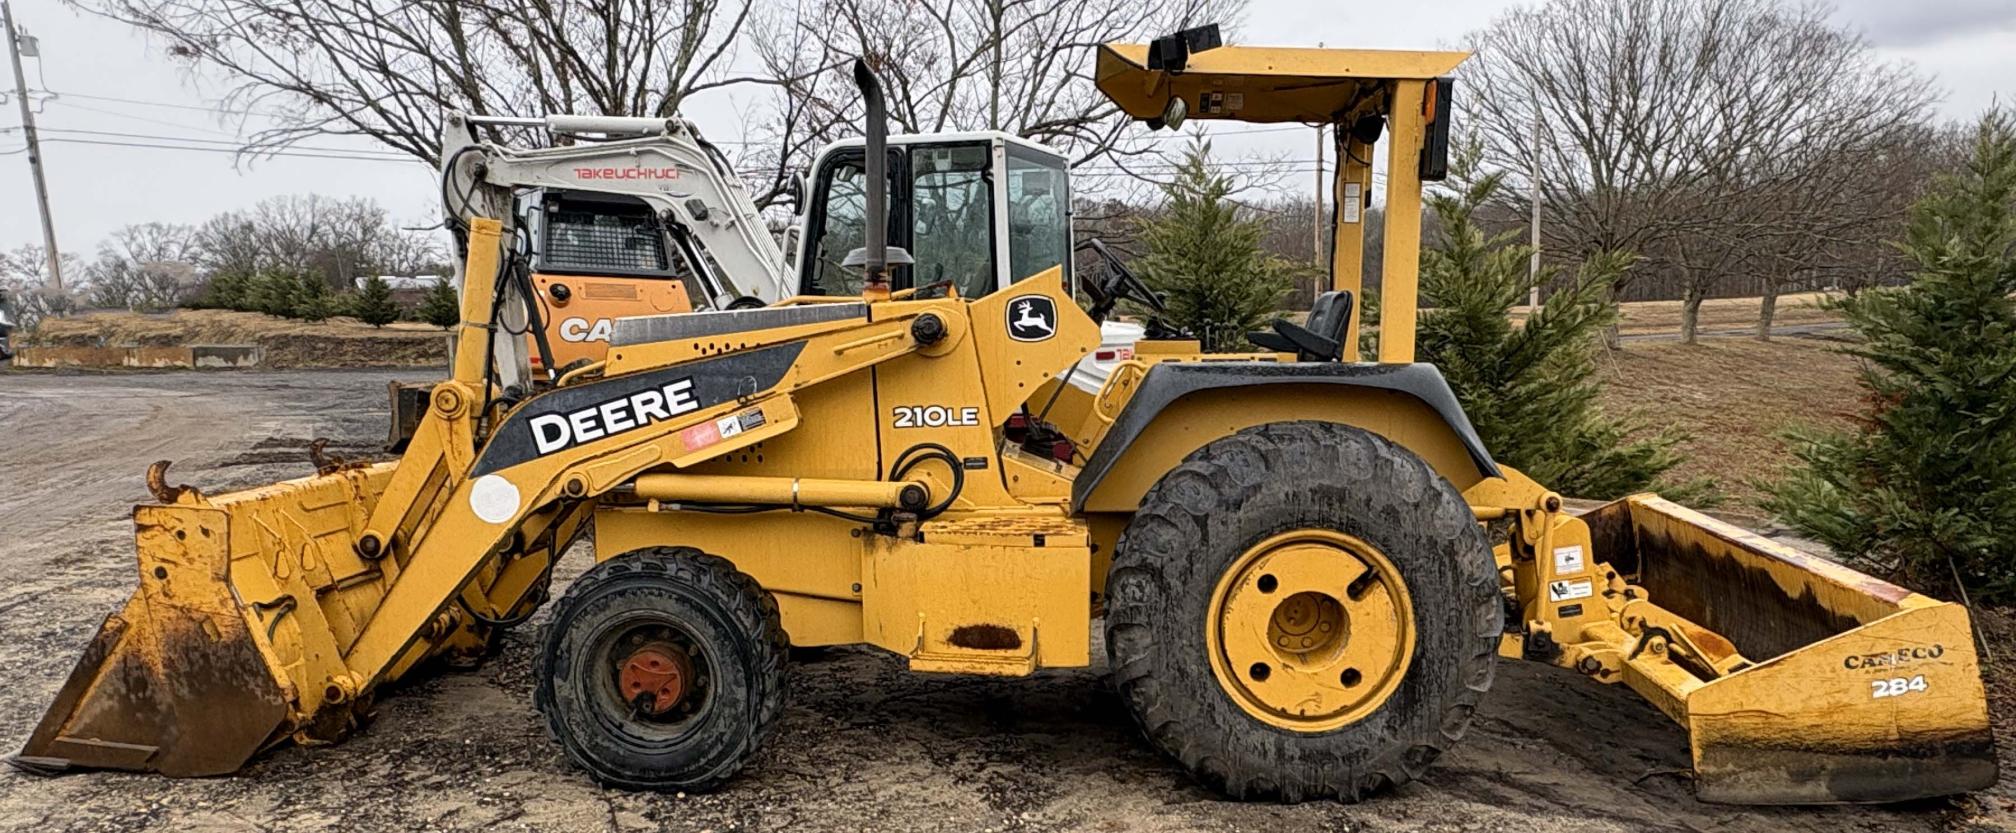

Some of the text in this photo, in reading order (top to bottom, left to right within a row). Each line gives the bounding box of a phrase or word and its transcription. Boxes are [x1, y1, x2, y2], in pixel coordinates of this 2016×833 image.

[559, 316, 612, 343] CA
[528, 378, 699, 455] DEERE
[893, 405, 980, 429] 210LE
[1871, 674, 1929, 699] 284
